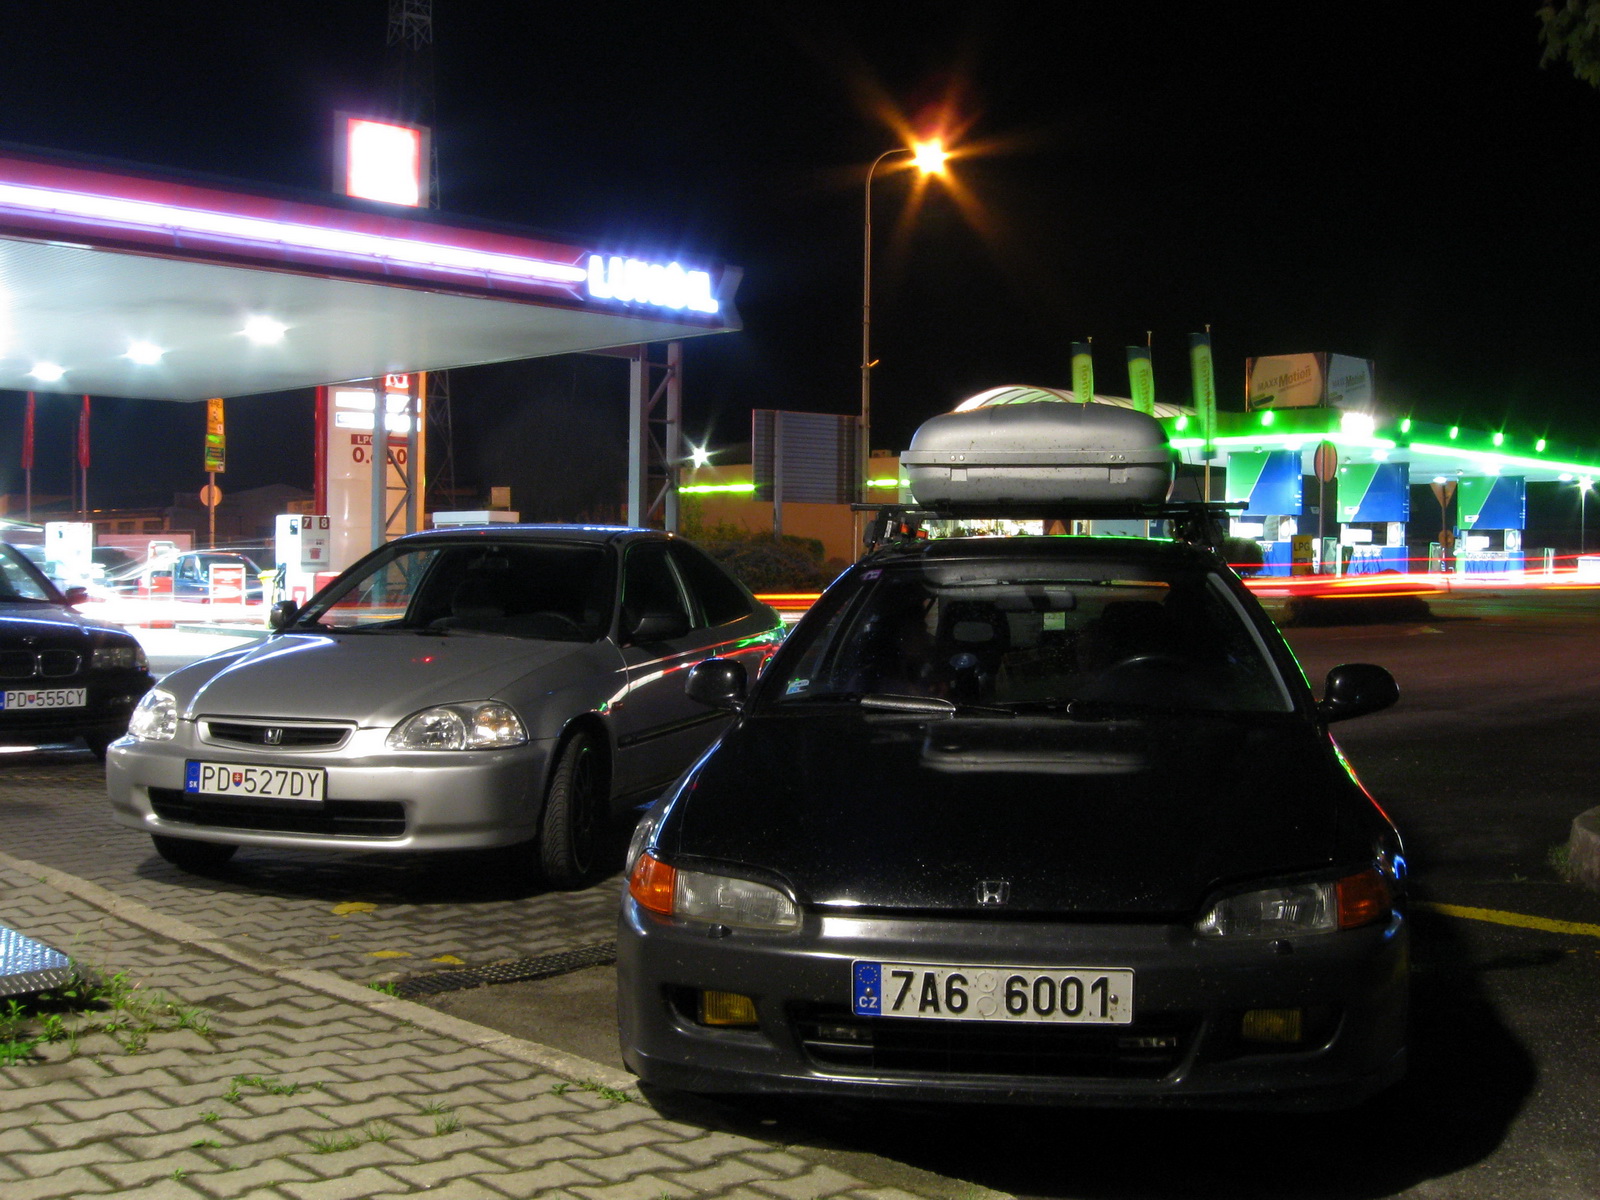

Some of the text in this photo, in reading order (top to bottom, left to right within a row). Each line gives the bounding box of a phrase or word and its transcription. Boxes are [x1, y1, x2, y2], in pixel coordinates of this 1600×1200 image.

[303, 518, 328, 528] 7 8
[1293, 543, 1311, 551] LPG
[244, 768, 320, 797] 527DY
[891, 970, 1110, 1018] 7A6 6001
[859, 996, 878, 1009] CZ
